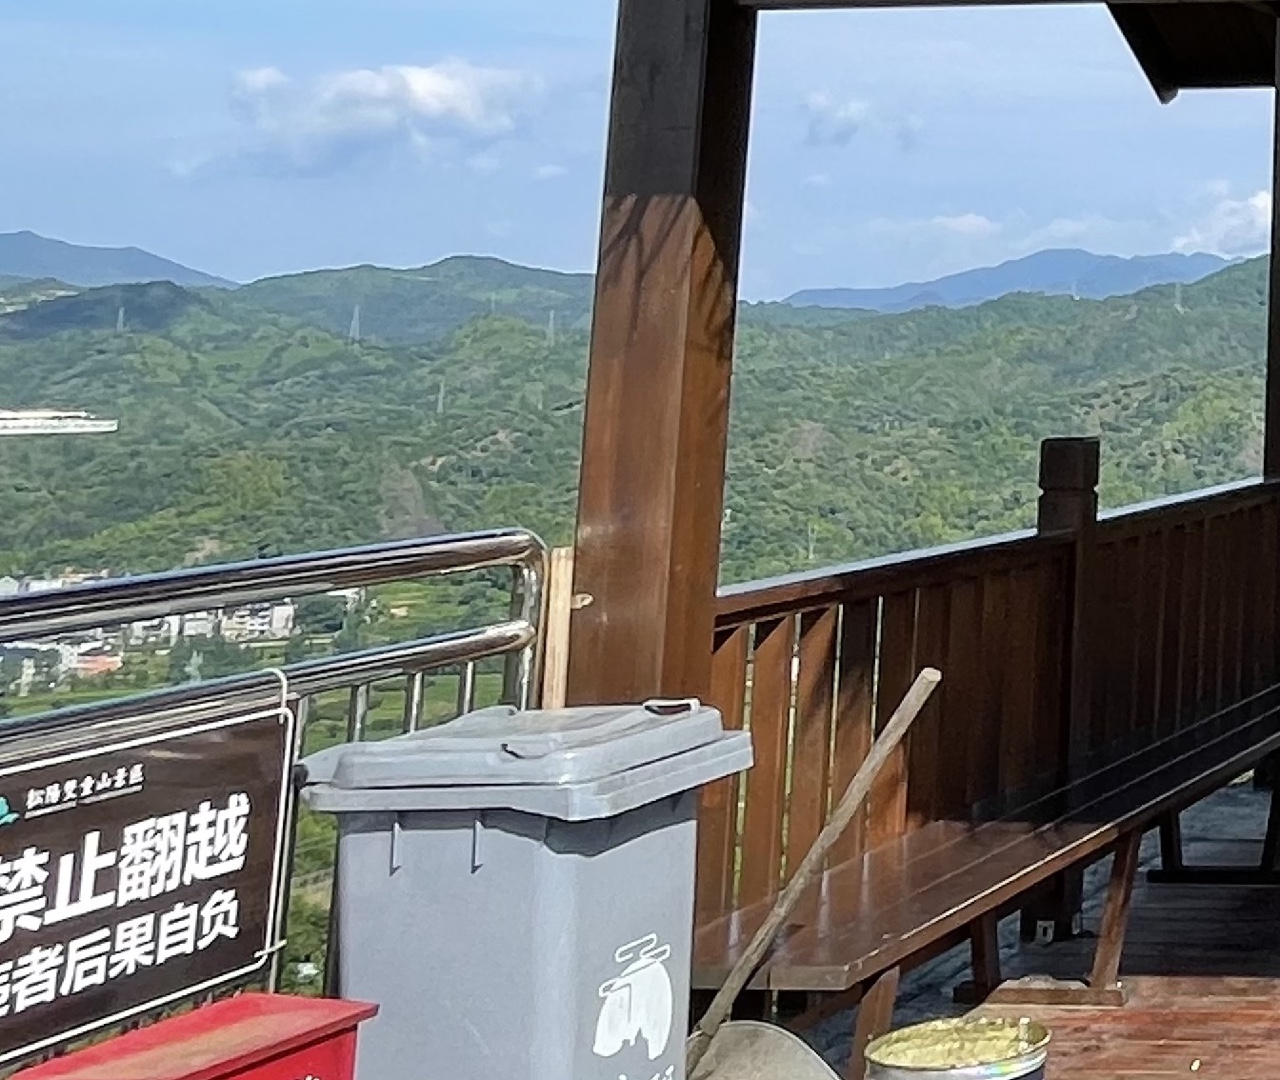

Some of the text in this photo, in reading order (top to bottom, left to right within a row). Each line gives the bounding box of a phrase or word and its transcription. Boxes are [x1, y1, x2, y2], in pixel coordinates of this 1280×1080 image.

[0, 888, 240, 1018] 者后果自负
